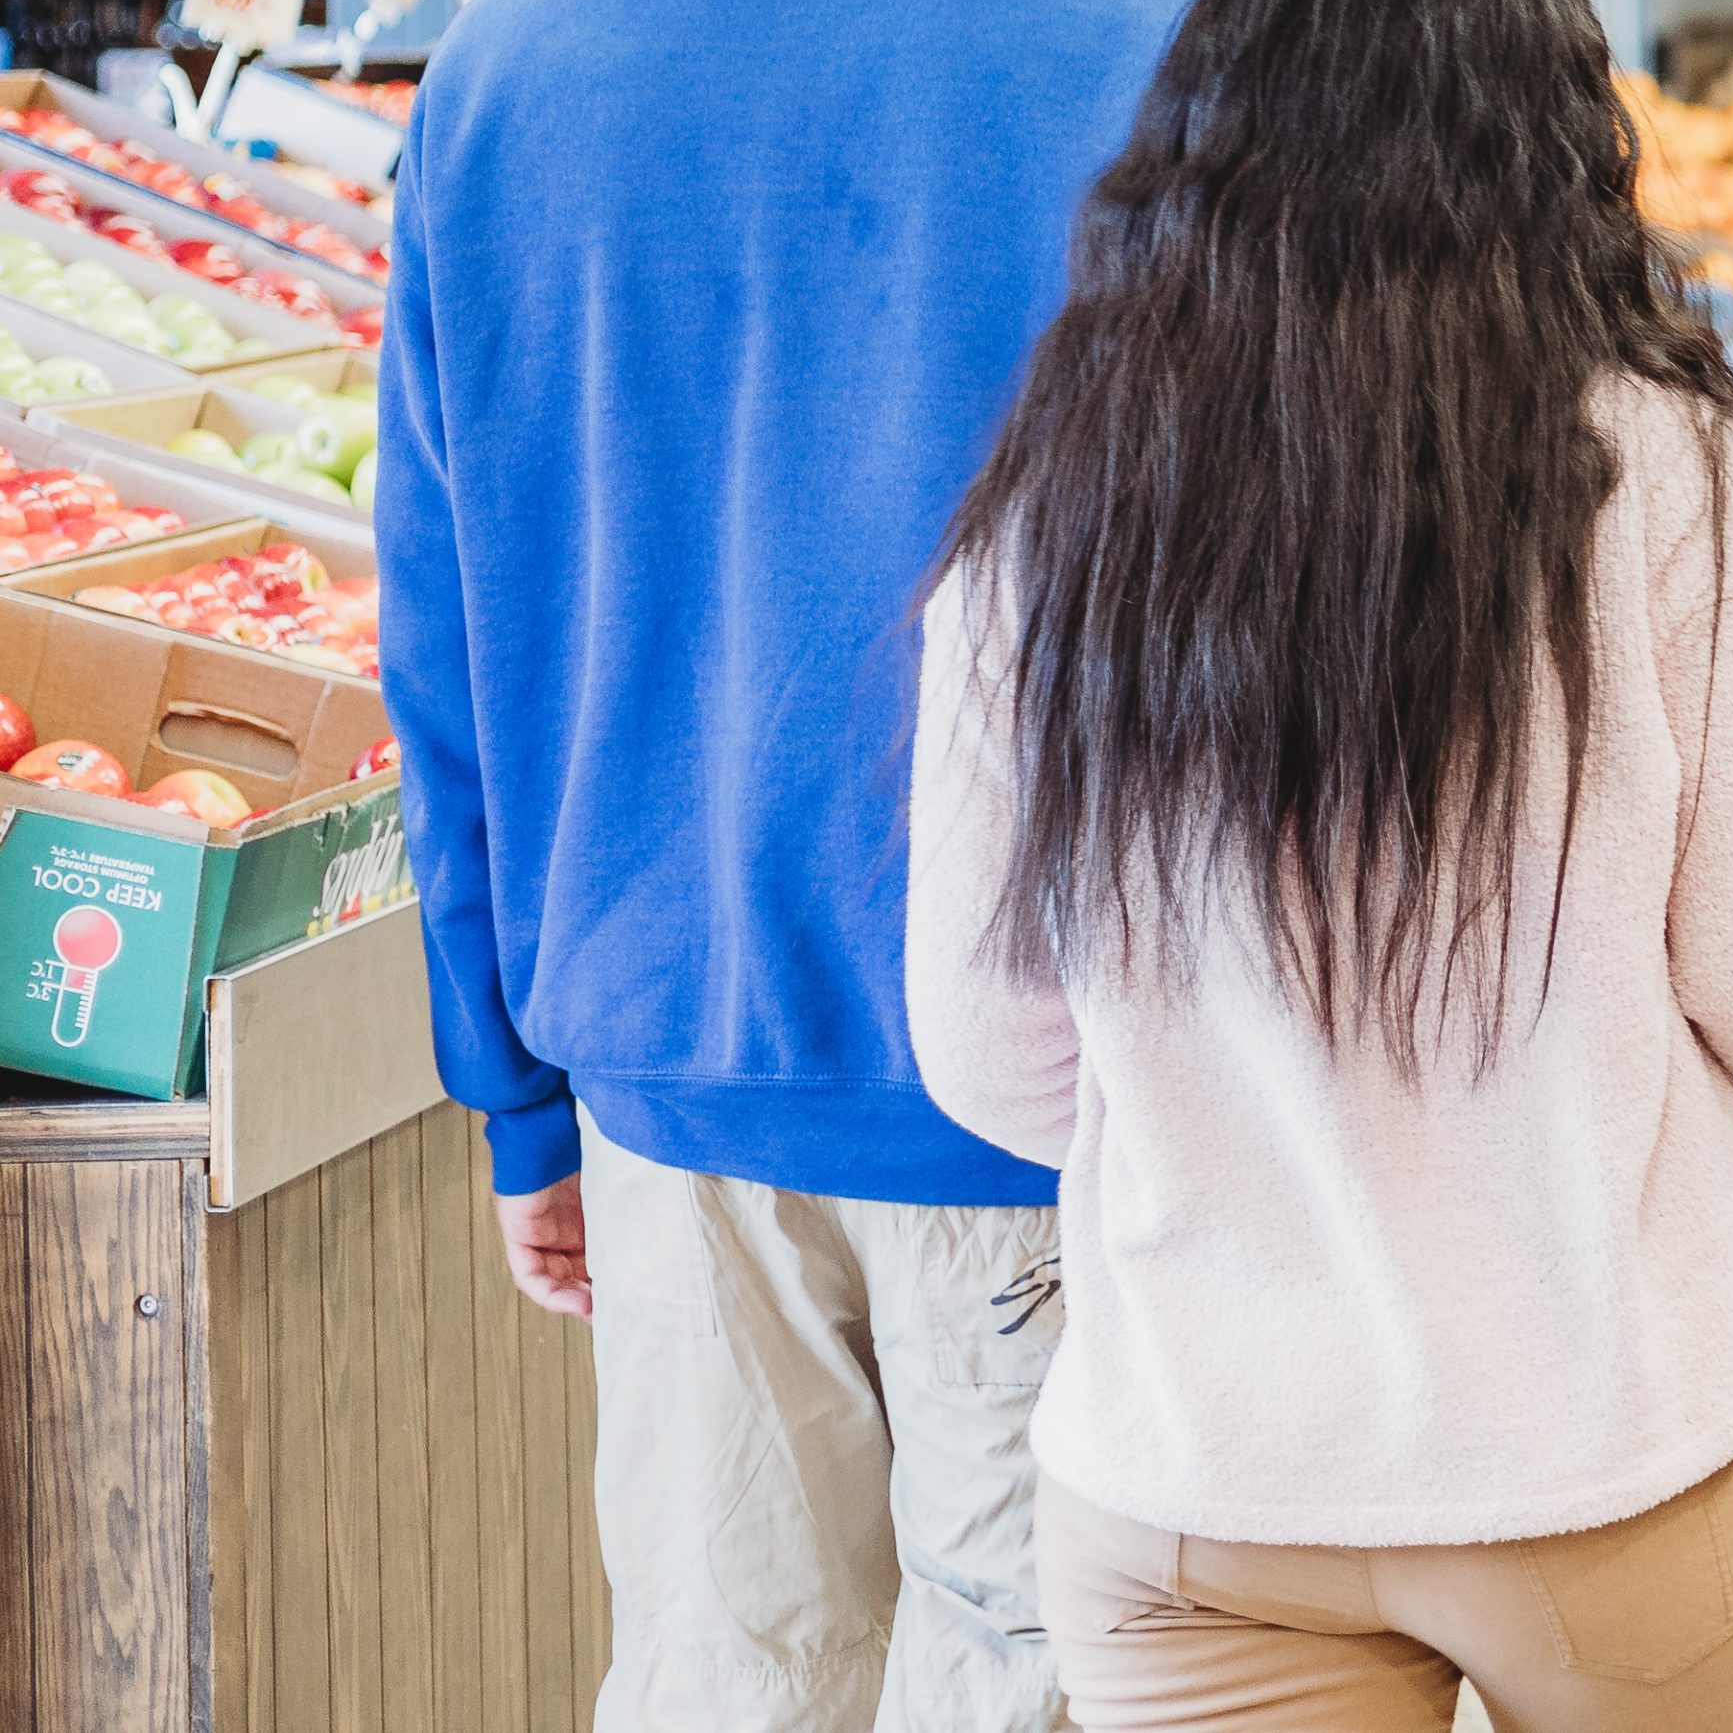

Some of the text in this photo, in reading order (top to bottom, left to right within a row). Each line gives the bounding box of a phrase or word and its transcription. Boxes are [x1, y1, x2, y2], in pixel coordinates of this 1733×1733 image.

[53, 857, 149, 885] OPTIMUM STORAGE
[89, 853, 155, 877] TEMPERATURE
[32, 866, 163, 912] KEEP COOL
